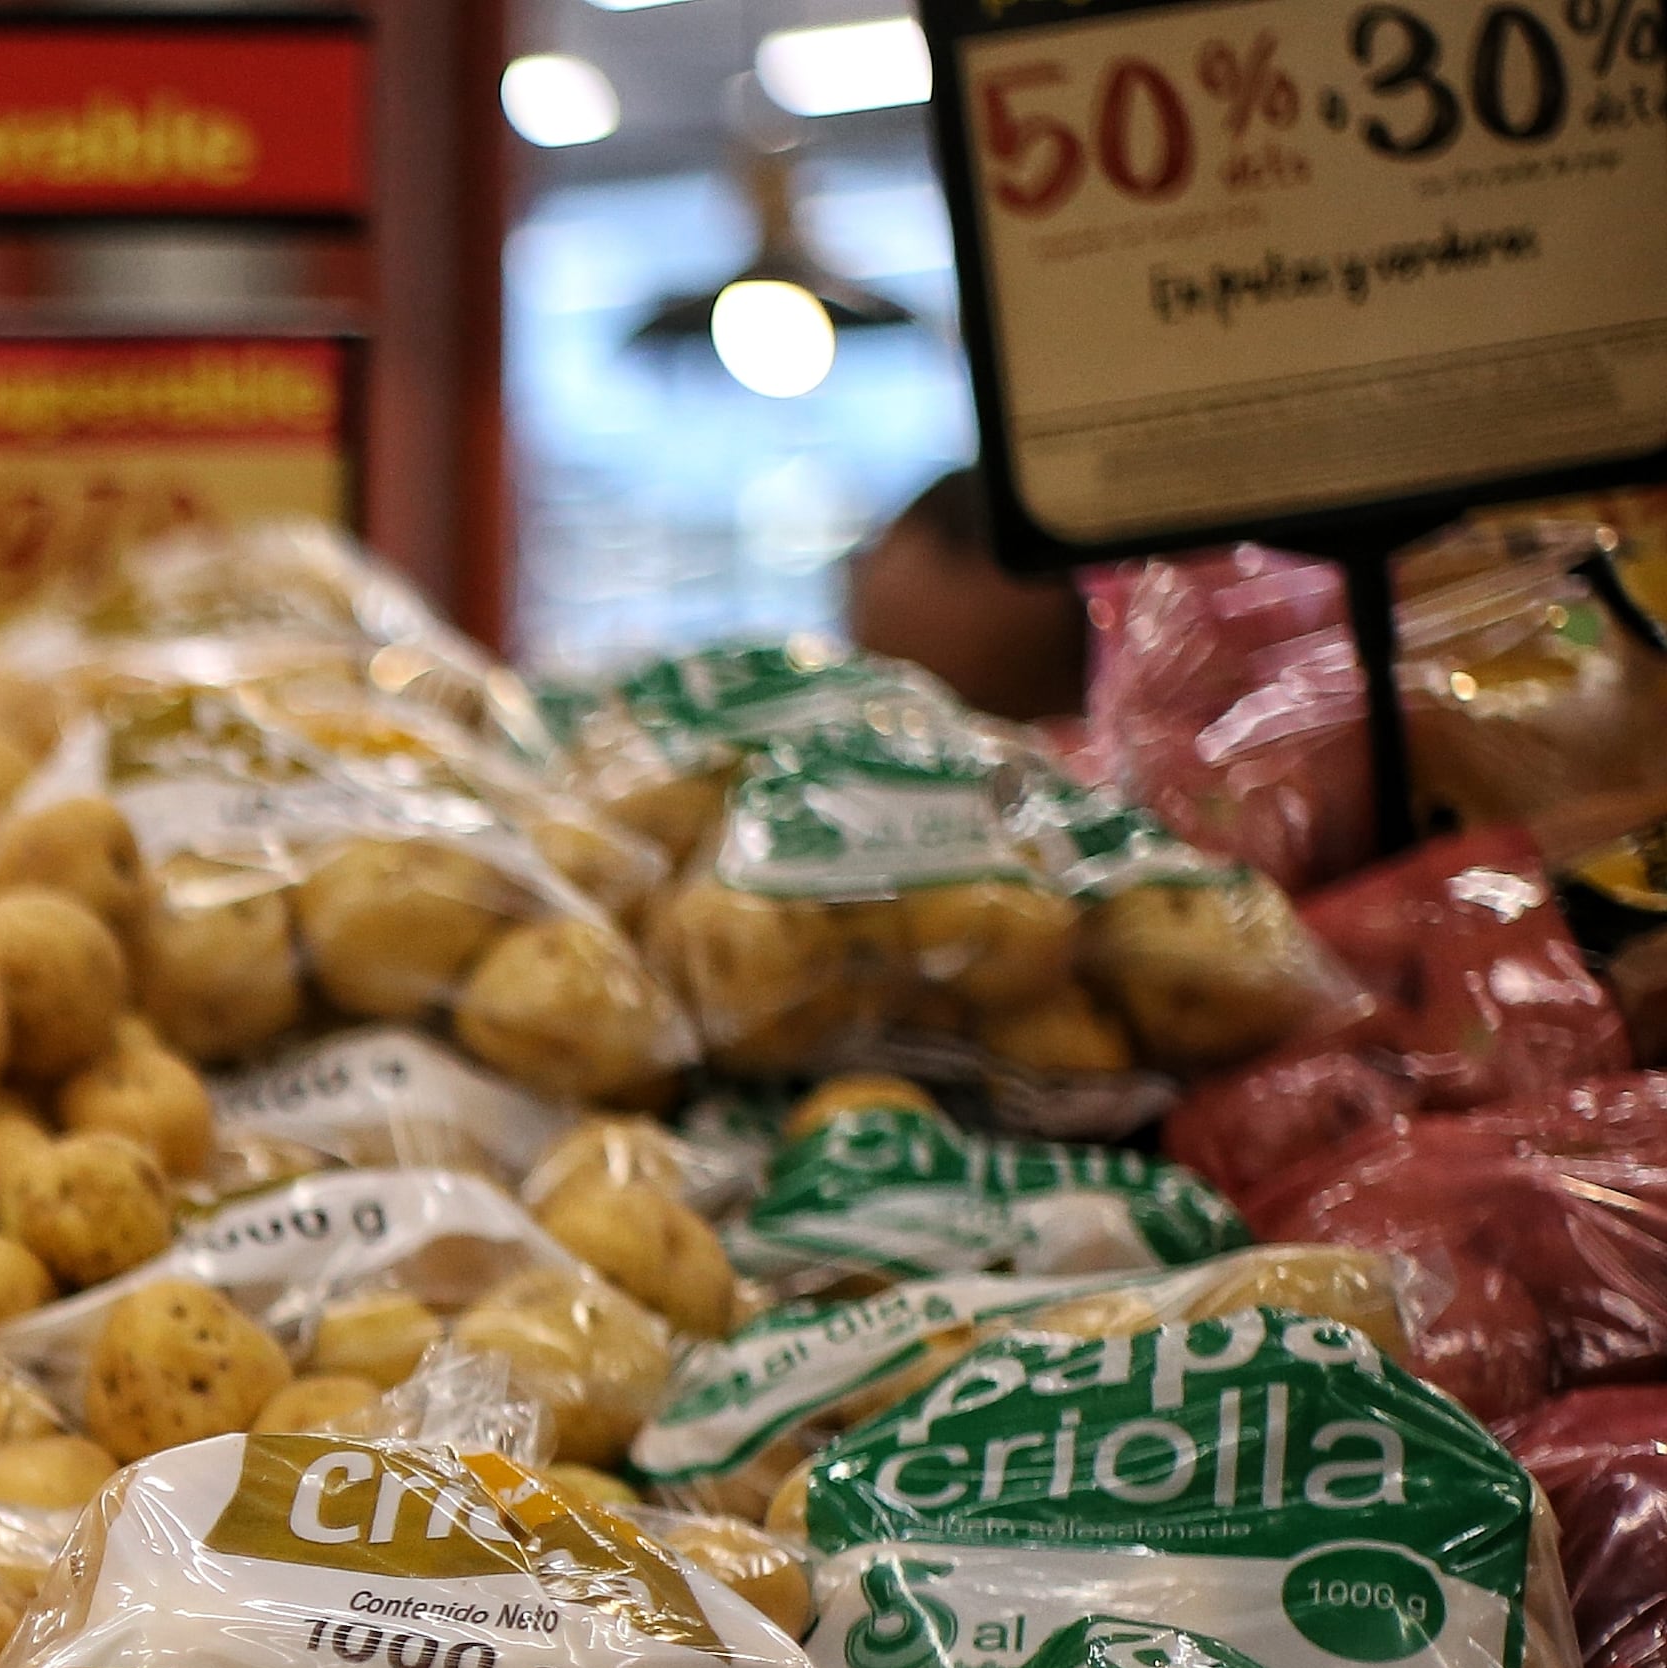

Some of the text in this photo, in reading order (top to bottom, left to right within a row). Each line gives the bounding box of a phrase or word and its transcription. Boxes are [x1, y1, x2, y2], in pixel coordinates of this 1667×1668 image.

[873, 1382, 1408, 1510] criolla
[349, 1590, 559, 1634] Contenido Neto
[1307, 1577, 1394, 1609] 1000
[972, 1613, 1026, 1652] al
